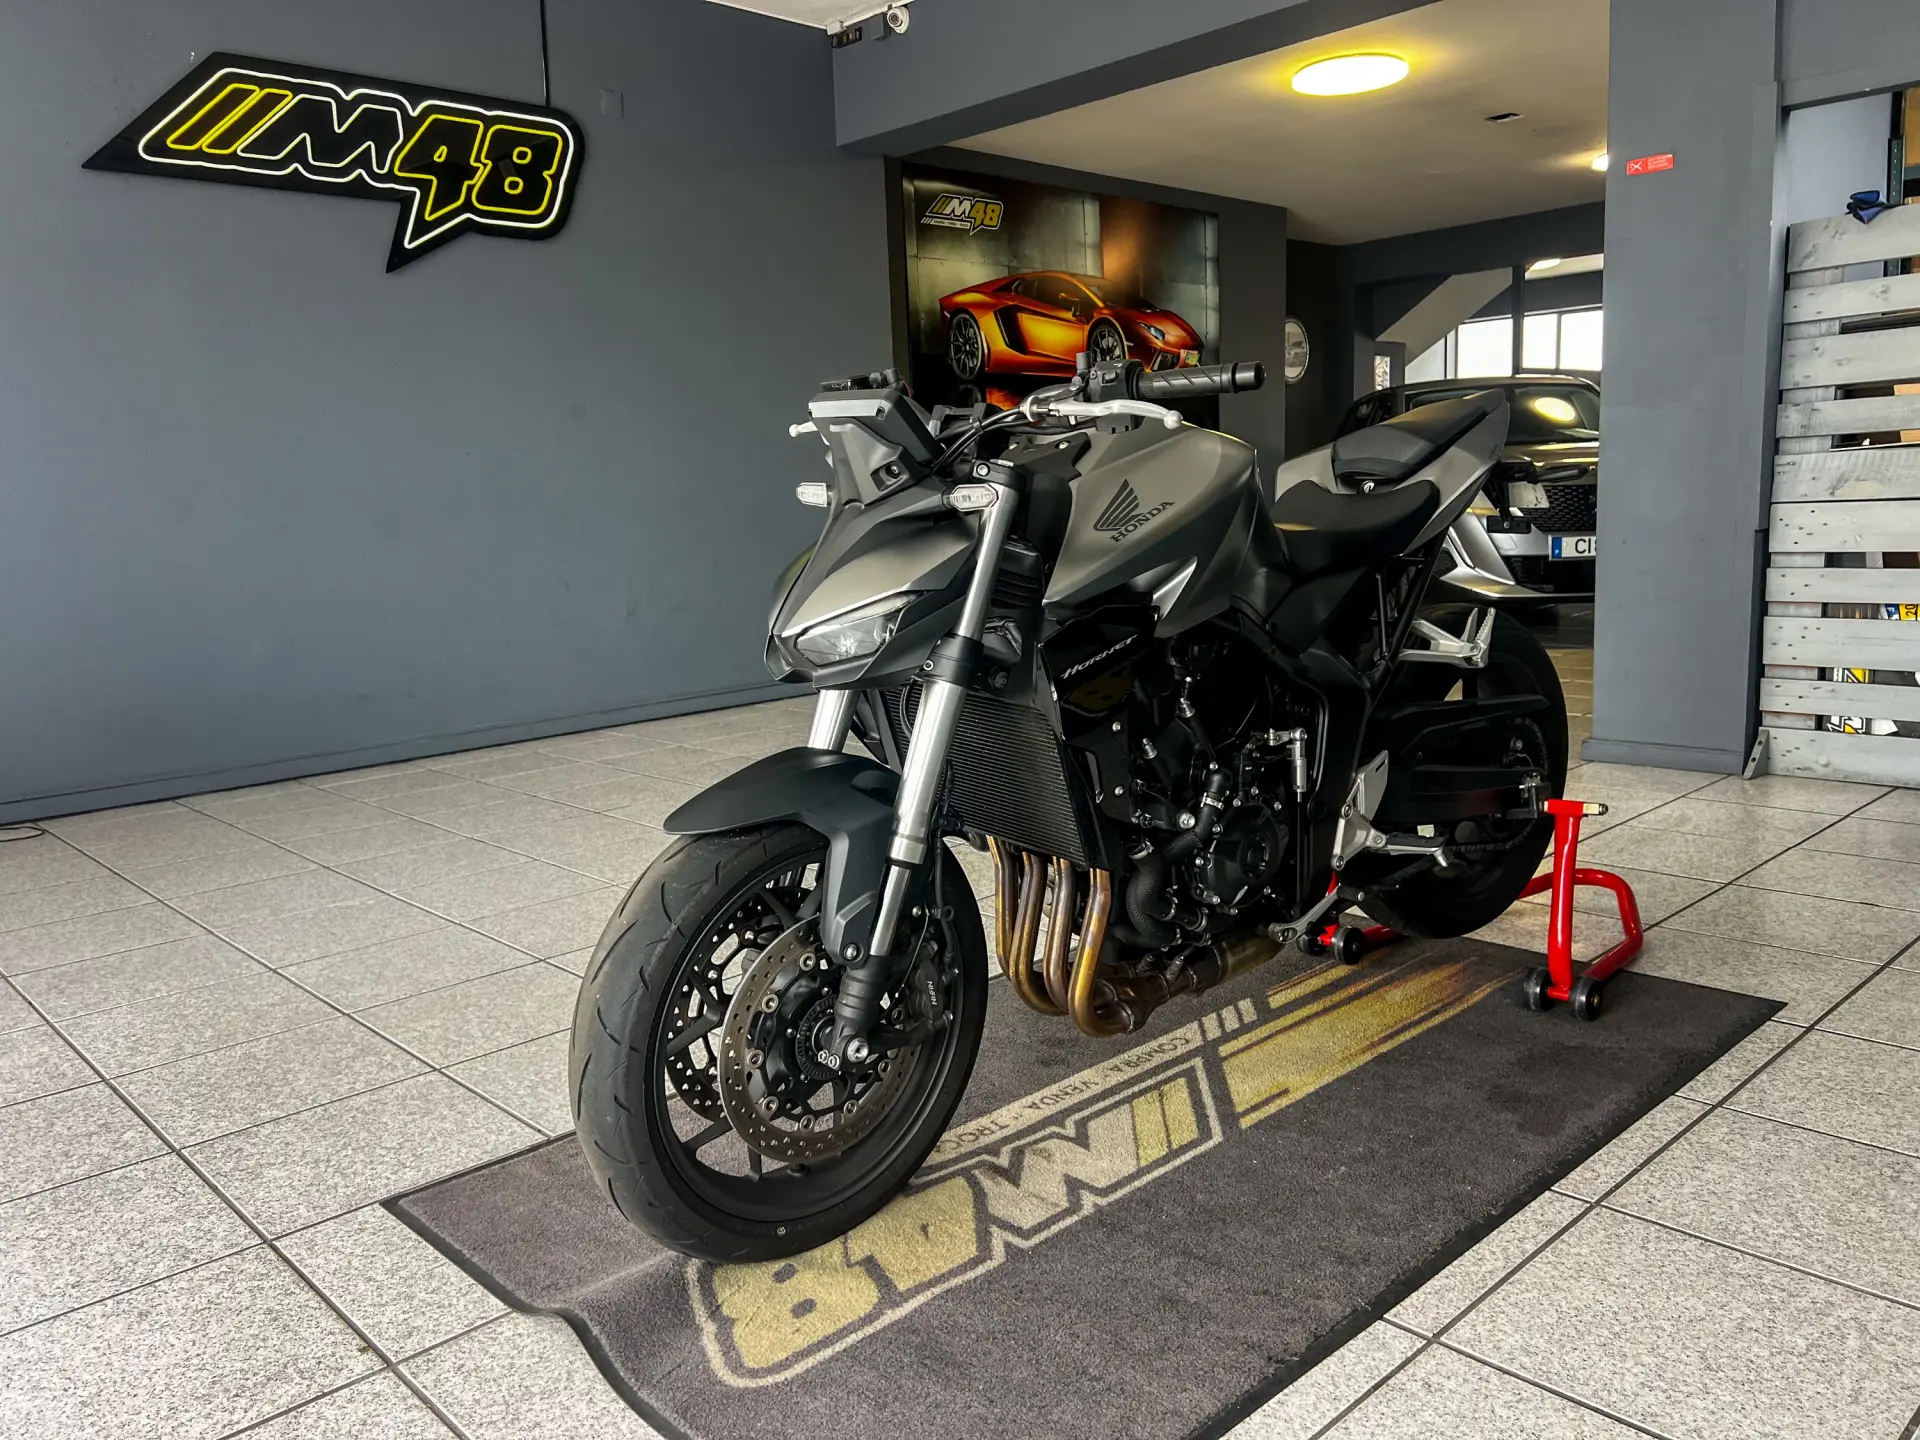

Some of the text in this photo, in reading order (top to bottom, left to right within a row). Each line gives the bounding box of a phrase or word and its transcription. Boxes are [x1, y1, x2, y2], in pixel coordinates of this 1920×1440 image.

[1109, 500, 1176, 543] HONDA
[1575, 538, 1596, 554] CI
[1059, 634, 1138, 680] HORNET
[1110, 1036, 1190, 1075] COMPRA
[1025, 1078, 1099, 1111] VENDA
